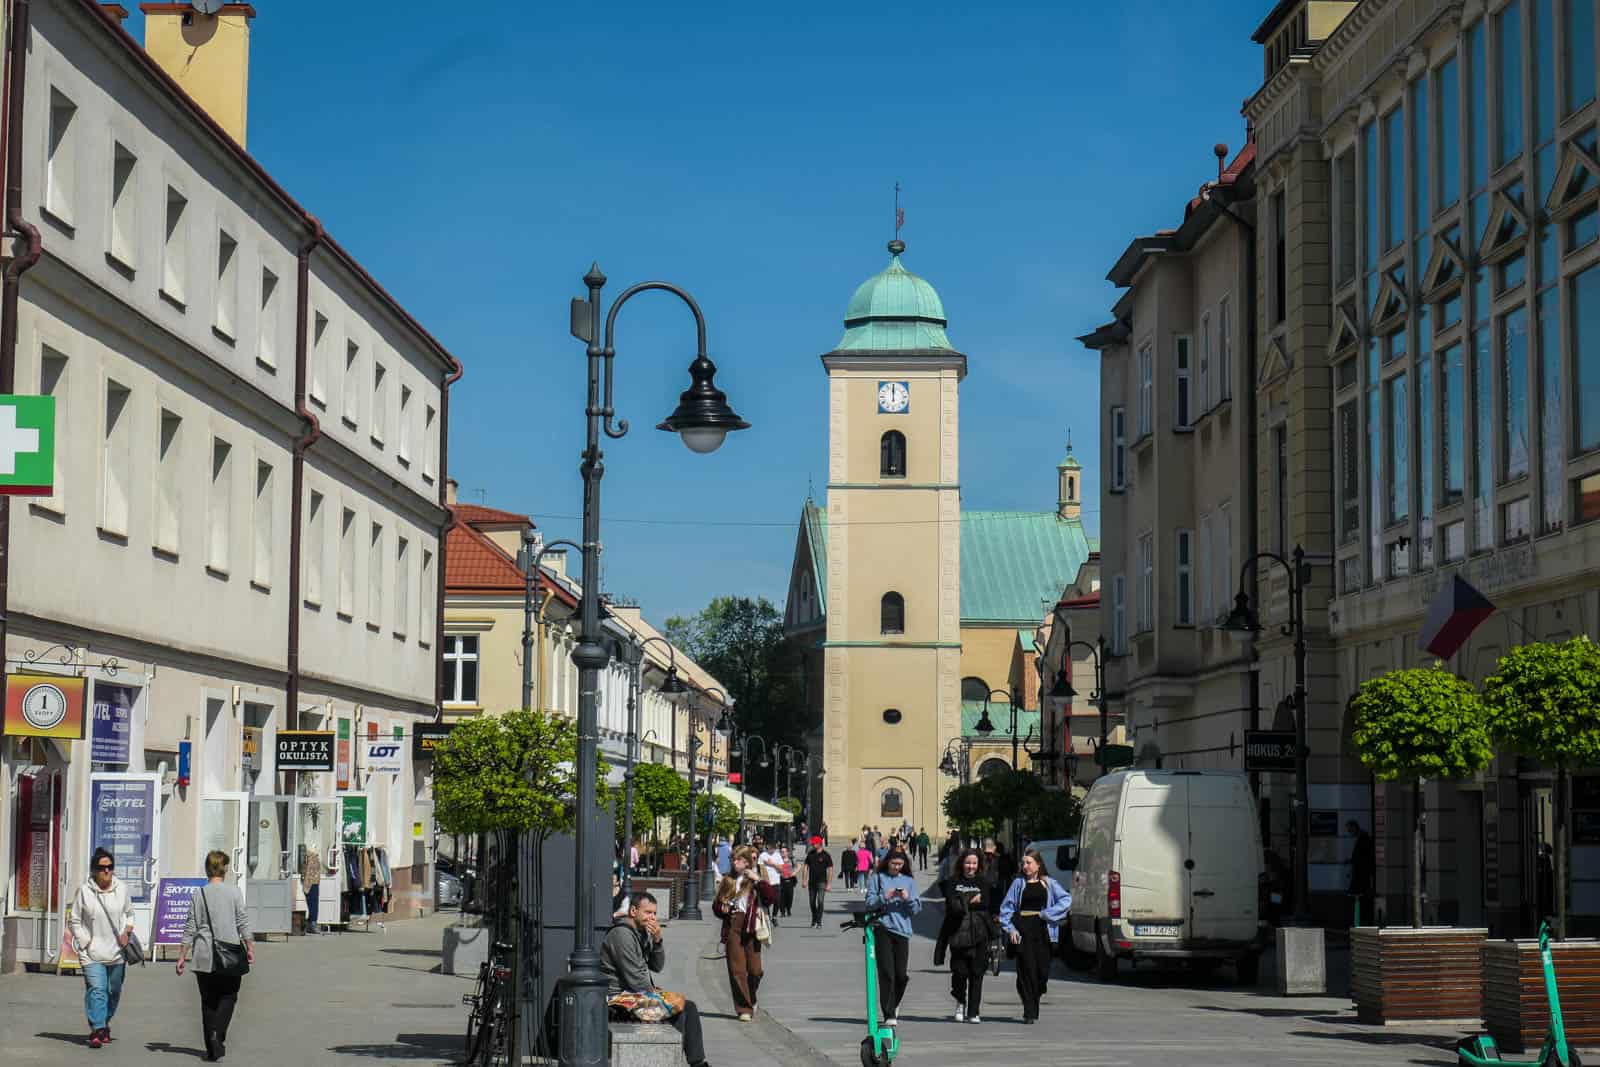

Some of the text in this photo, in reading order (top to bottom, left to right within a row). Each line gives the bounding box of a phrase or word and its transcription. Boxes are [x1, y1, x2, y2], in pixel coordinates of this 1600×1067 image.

[94, 703, 111, 720] YTEL
[279, 741, 329, 751] OPTYK
[279, 752, 329, 760] OKULISTA
[368, 746, 401, 757] LOT
[102, 798, 147, 808] SKYTEL
[166, 886, 199, 894] SKYTE
